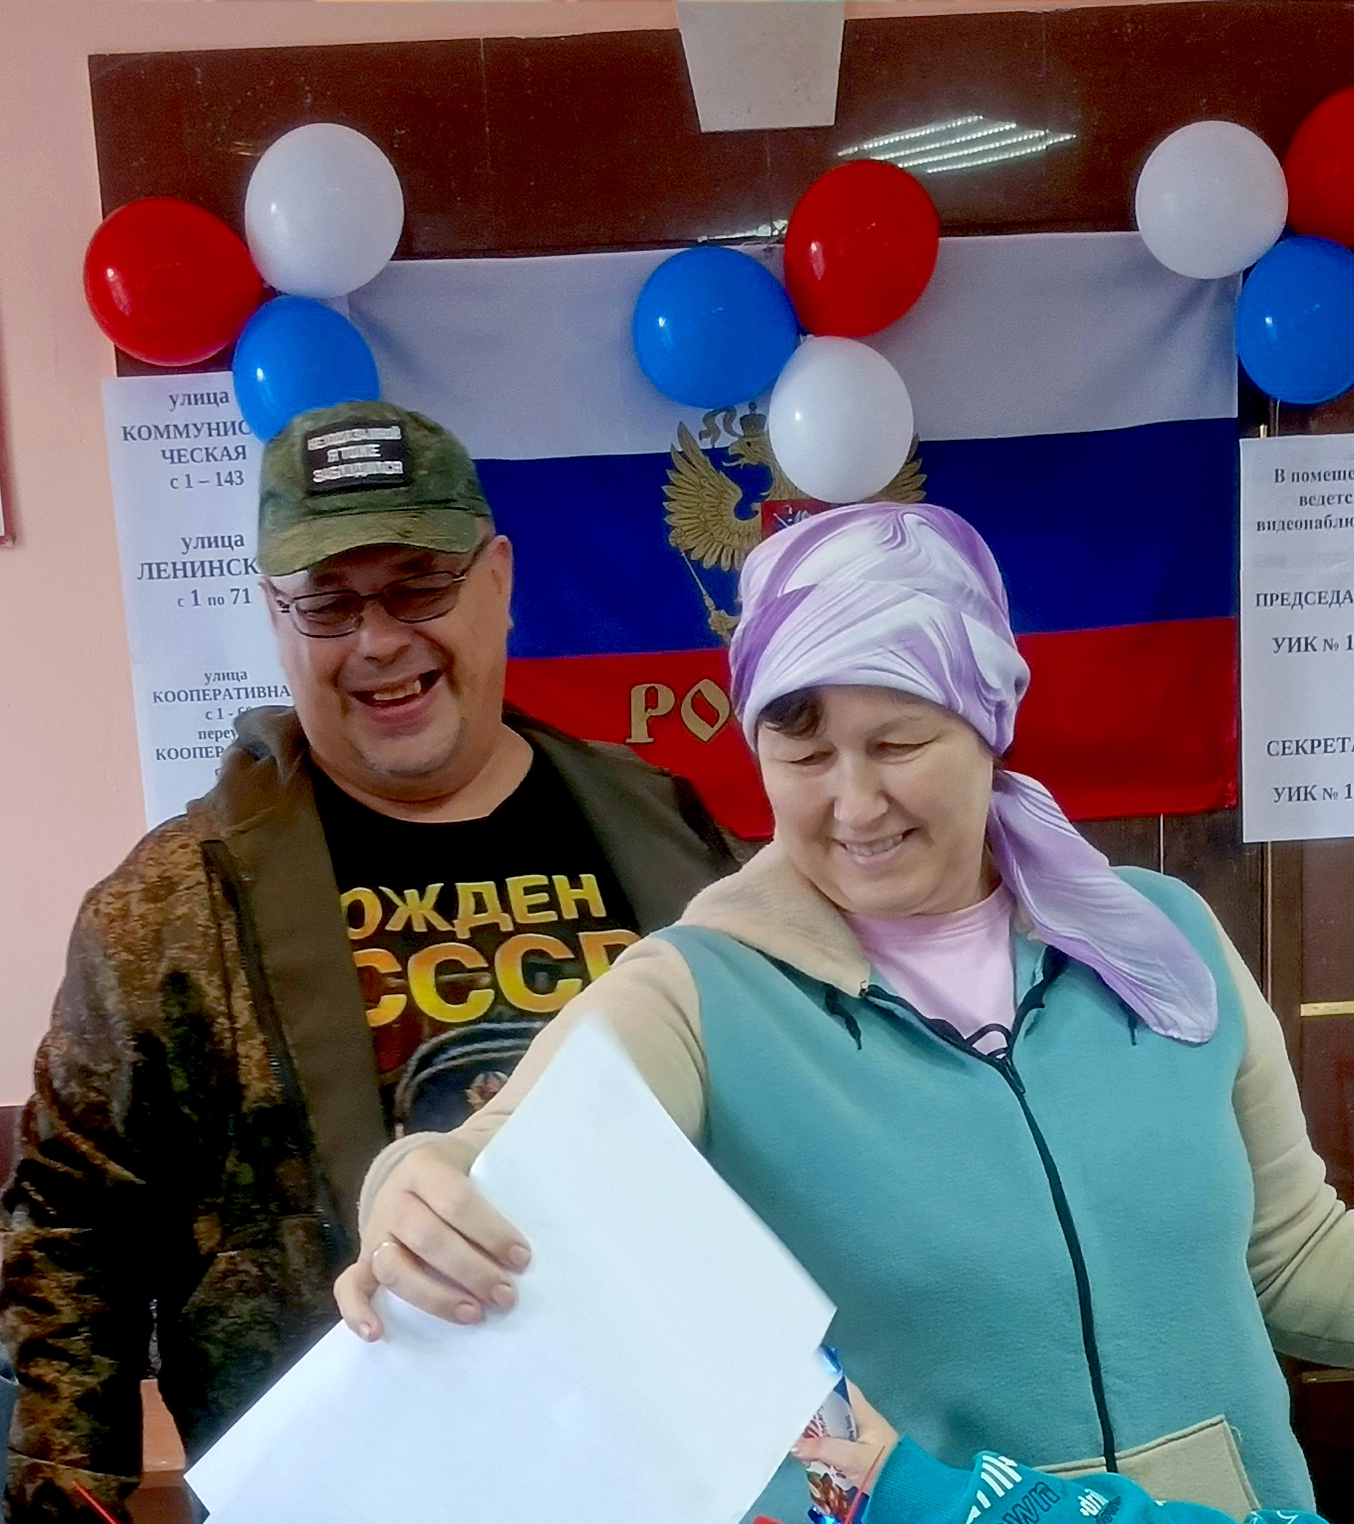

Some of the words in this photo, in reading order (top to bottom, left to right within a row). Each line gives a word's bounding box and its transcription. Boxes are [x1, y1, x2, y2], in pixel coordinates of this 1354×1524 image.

[169, 390, 229, 411] улица
[161, 445, 247, 464] ЧЕСКАЯ
[170, 477, 179, 489] с
[185, 474, 194, 488] 1
[216, 470, 244, 487] 143
[1274, 469, 1285, 482] В
[181, 534, 245, 554] улица
[177, 598, 184, 607] с
[191, 590, 201, 606] 1
[208, 596, 225, 606] по
[230, 588, 252, 604] 71
[1272, 636, 1317, 653] УИК
[1323, 638, 1339, 652] №
[205, 671, 248, 685] улица
[205, 711, 212, 720] с
[217, 708, 223, 719] 1
[1273, 785, 1317, 802] УИК
[1322, 788, 1338, 800] №
